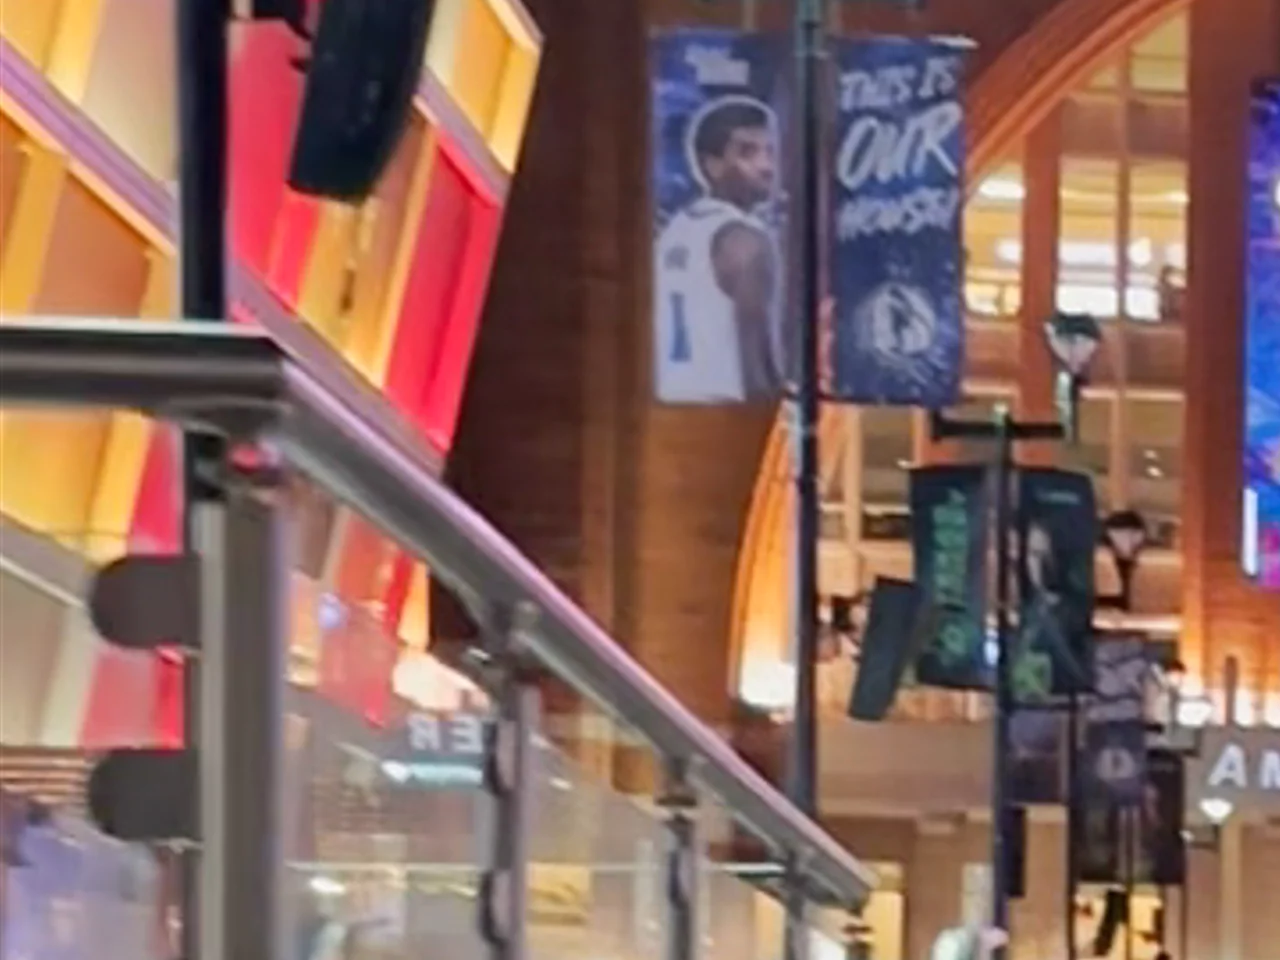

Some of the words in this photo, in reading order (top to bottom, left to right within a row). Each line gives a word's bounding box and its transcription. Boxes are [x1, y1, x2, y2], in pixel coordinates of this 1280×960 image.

[840, 66, 917, 112] THIS
[917, 57, 957, 99] IS
[837, 102, 963, 191] OUR
